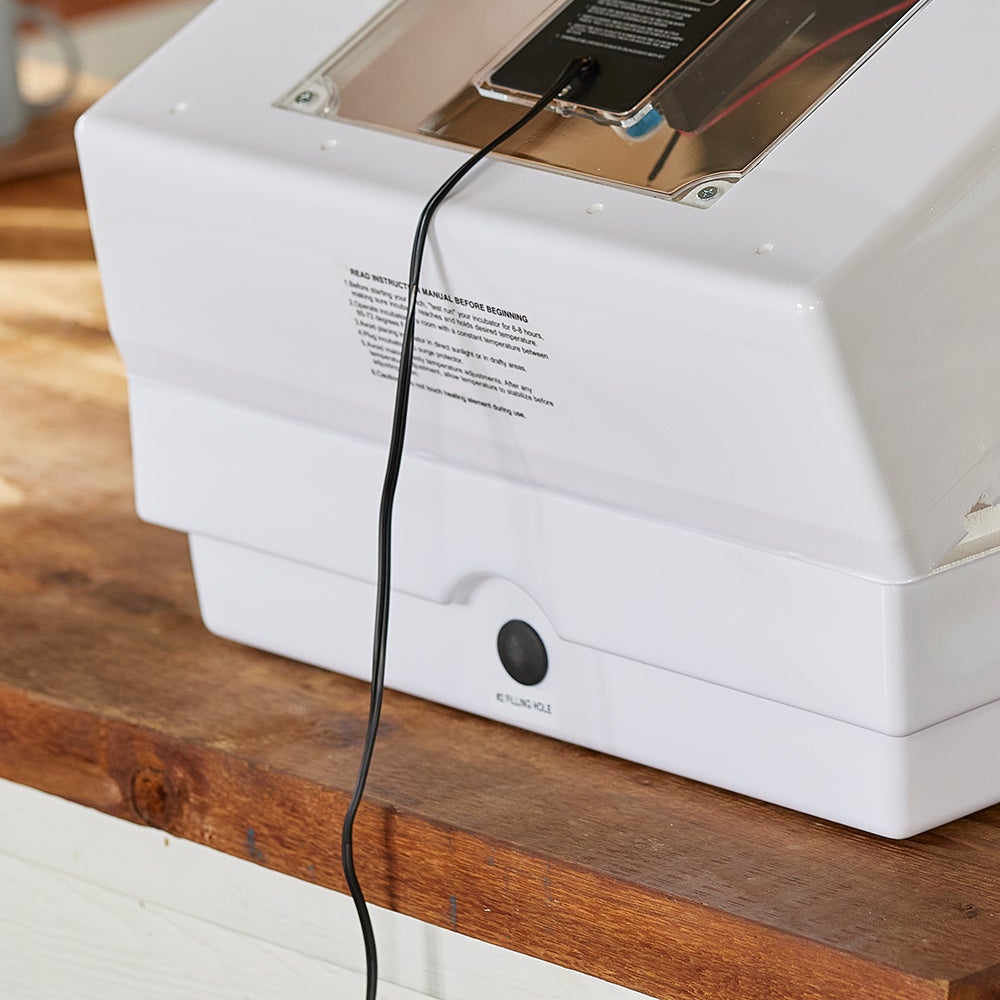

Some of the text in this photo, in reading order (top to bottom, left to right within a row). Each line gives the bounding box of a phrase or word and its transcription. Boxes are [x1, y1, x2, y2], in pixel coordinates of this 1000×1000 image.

[349, 267, 371, 281] READ
[421, 287, 454, 304] MANUAL
[454, 296, 485, 312] BEFORE
[486, 304, 529, 323] BEGINNING
[417, 309, 443, 321] reaches
[443, 315, 456, 325] and
[456, 318, 474, 330] holds
[474, 323, 498, 337] desired
[456, 310, 471, 320] your
[471, 313, 501, 329] incubator
[501, 321, 511, 331] for
[456, 329, 483, 342] constant
[483, 336, 521, 353] temperature
[425, 358, 464, 375] temperature
[451, 346, 475, 358] sunlight
[489, 356, 507, 369] drafty
[443, 390, 467, 404] heating
[467, 397, 493, 409] element
[492, 403, 513, 417] during
[460, 376, 499, 392] temperature
[506, 389, 533, 402] stabilize
[533, 395, 555, 408] before
[533, 701, 553, 715] HOLE
